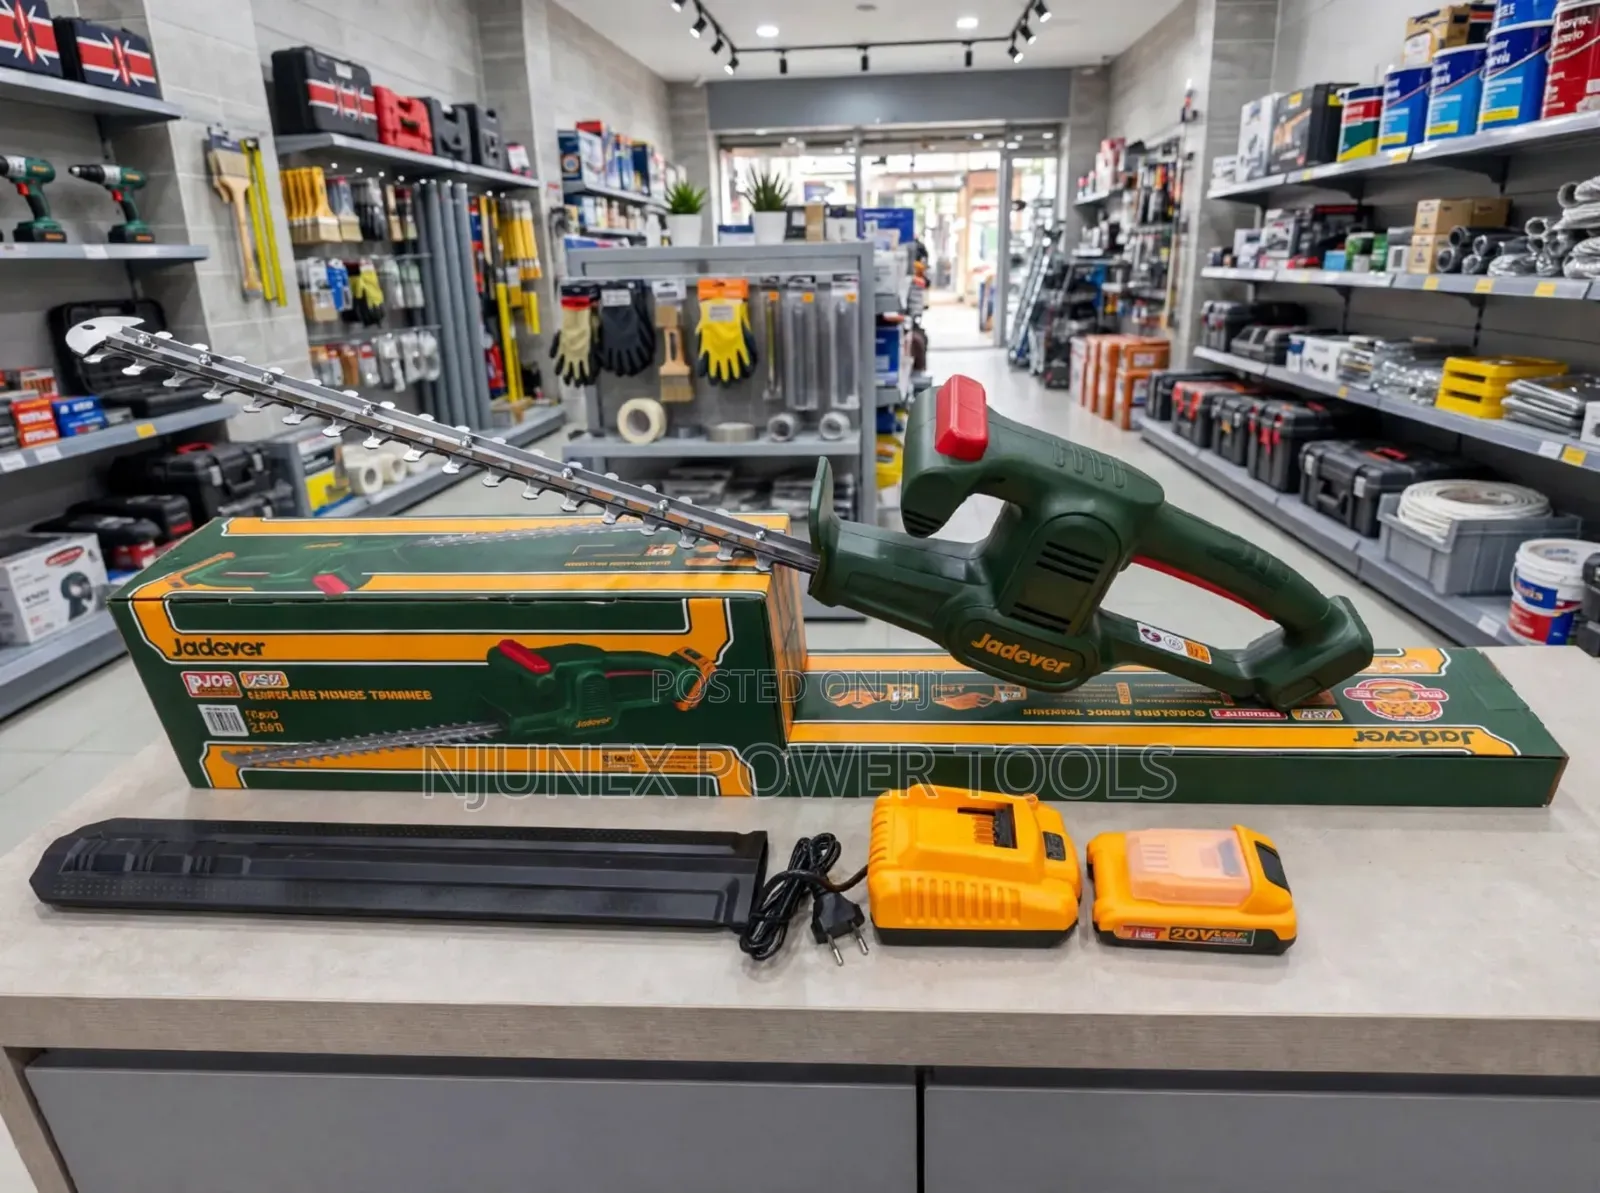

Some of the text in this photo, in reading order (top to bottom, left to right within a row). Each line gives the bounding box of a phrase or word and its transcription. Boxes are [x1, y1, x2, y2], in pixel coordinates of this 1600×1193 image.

[172, 637, 266, 656] Jadever
[970, 633, 1071, 674] Jadever
[1353, 730, 1475, 746] Jadever
[1171, 927, 1214, 941] 20V
